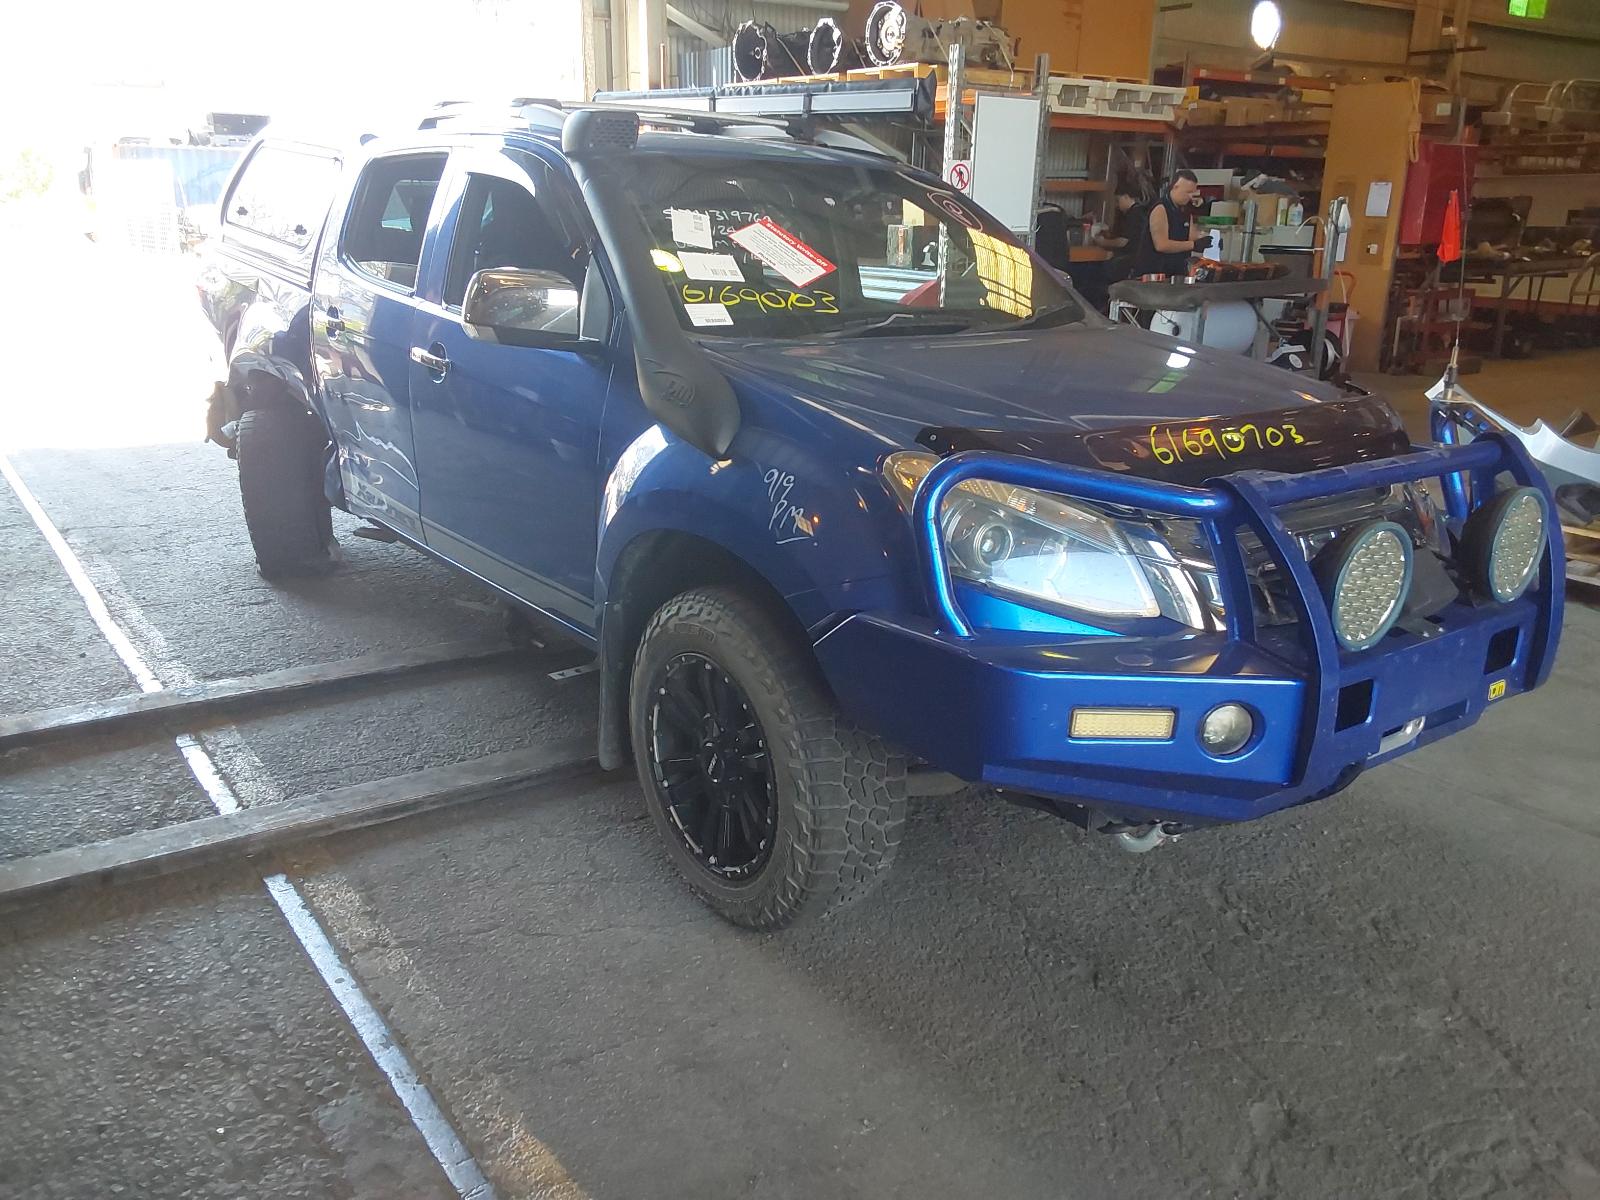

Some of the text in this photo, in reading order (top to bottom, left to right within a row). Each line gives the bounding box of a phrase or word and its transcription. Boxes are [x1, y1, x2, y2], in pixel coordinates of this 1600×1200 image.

[766, 222, 797, 246] Statutory
[796, 243, 829, 268] Write-Off
[682, 283, 840, 314] 61690703
[1150, 423, 1305, 465] 61690703
